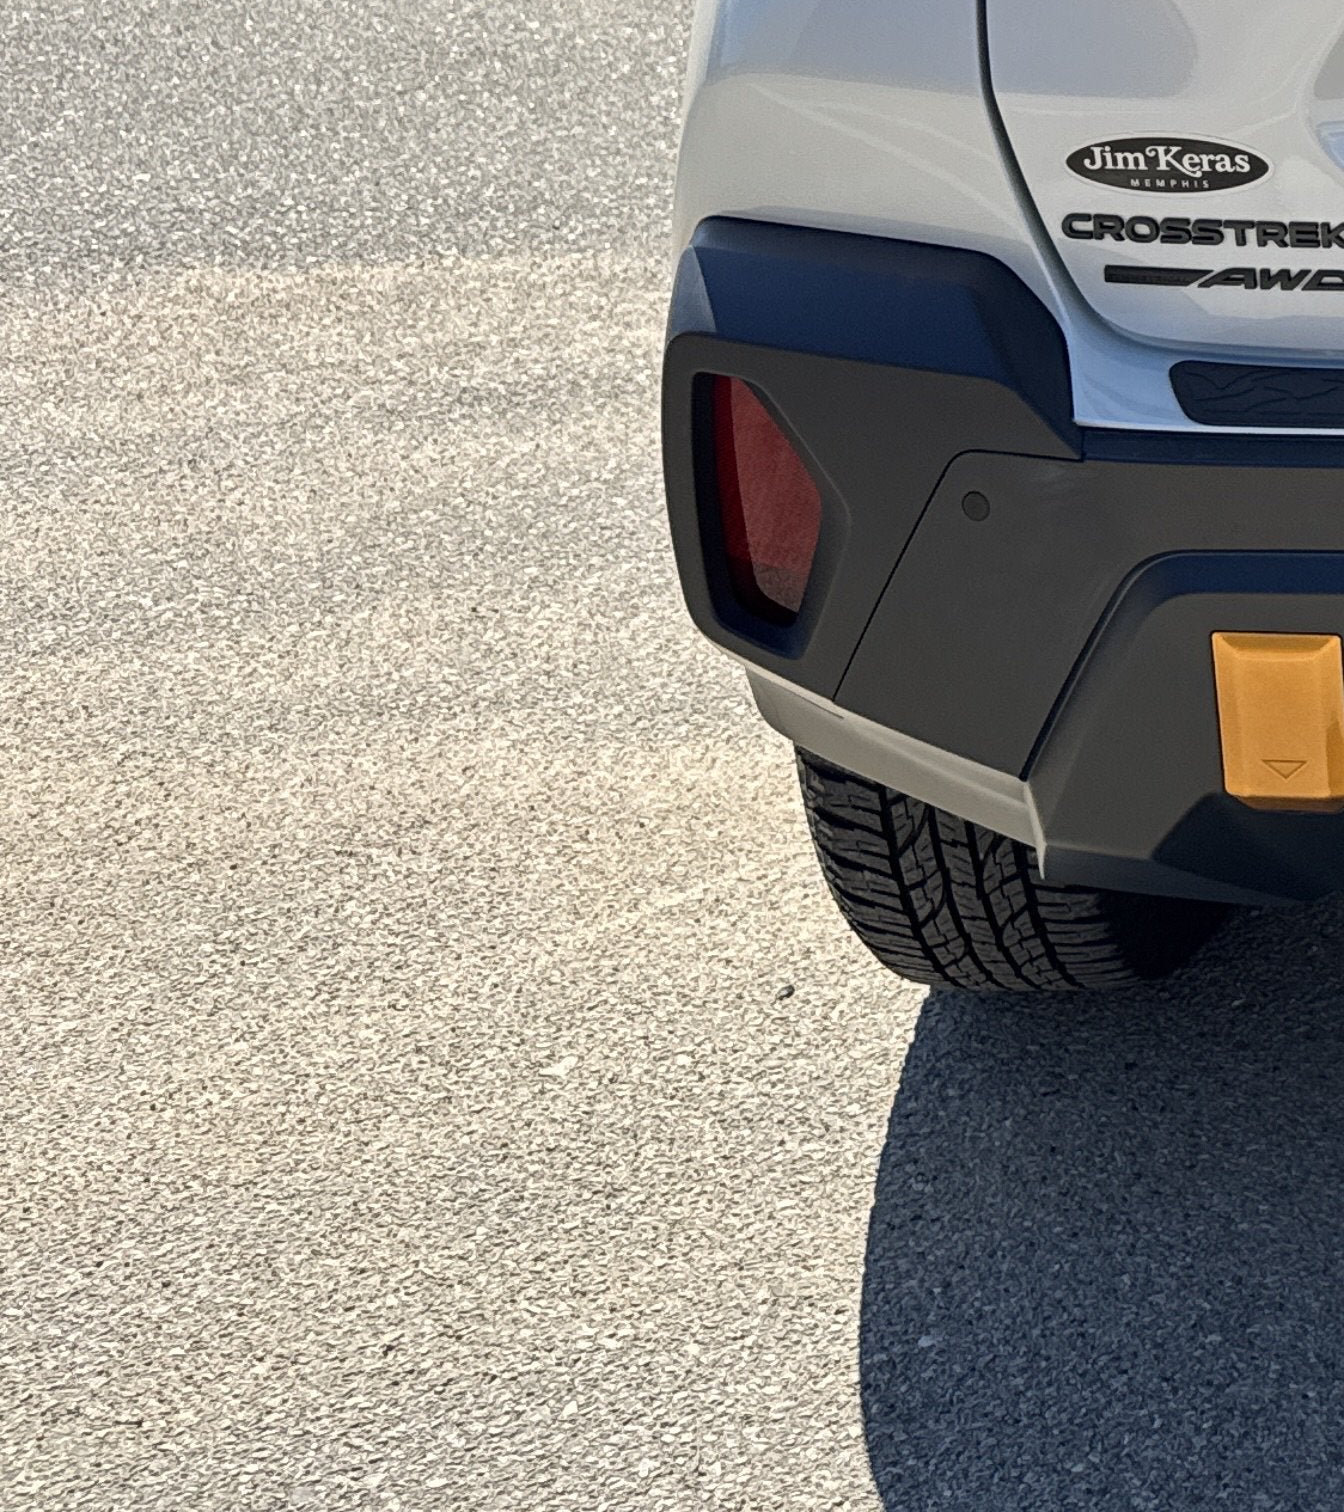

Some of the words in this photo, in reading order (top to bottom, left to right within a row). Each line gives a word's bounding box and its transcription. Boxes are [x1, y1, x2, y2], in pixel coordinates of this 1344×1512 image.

[1083, 146, 1145, 171] Jim
[1145, 146, 1251, 178] Keras
[1130, 177, 1210, 189] MEMPHIS
